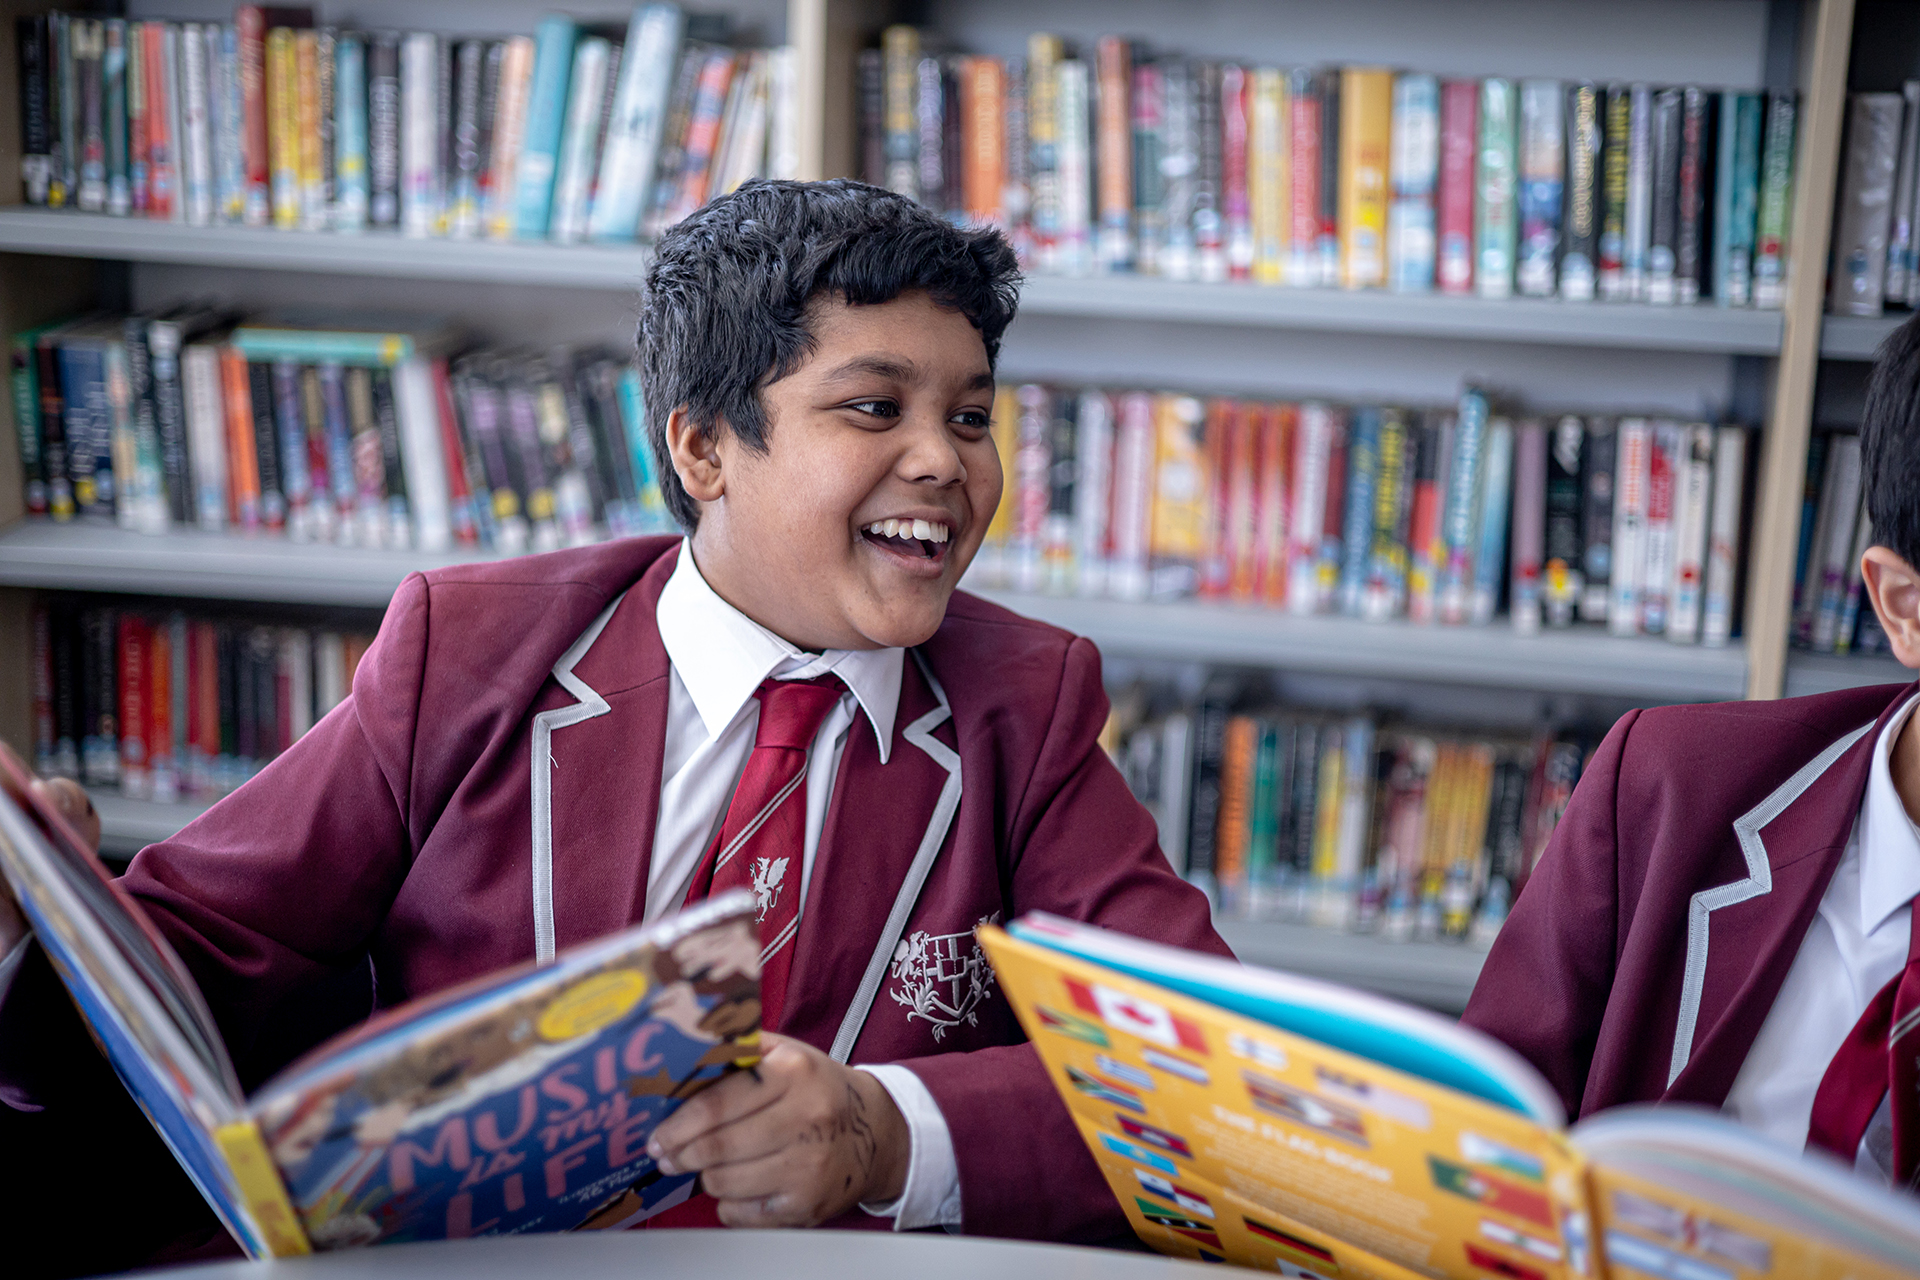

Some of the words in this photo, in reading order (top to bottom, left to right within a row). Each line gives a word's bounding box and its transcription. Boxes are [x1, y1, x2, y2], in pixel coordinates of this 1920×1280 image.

[388, 1022, 665, 1193] MUSIC
[538, 1091, 630, 1152] my
[446, 1110, 651, 1239] LIFE
